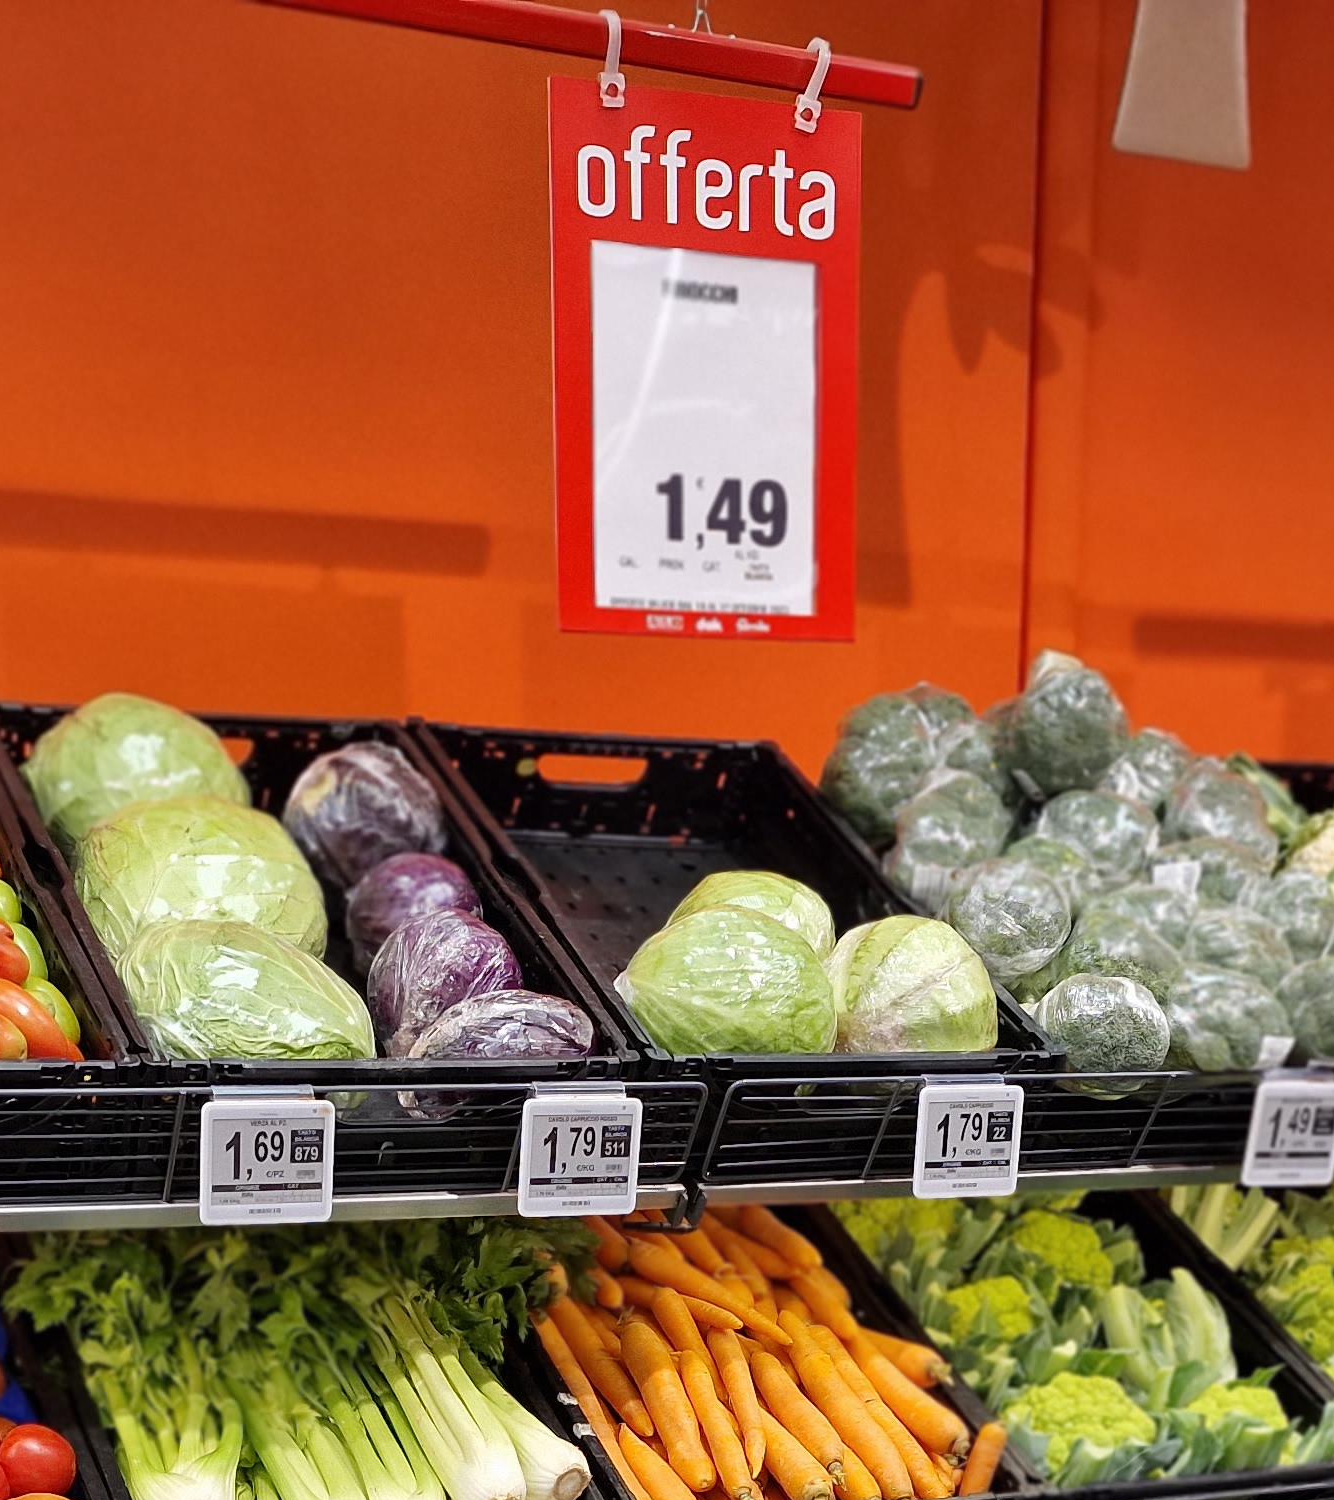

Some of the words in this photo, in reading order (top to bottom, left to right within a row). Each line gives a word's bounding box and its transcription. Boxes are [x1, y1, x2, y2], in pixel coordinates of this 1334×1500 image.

[576, 125, 836, 240] offerta
[656, 474, 788, 550] 1,49
[605, 1141, 625, 1156] 511
[937, 1113, 982, 1158] 1,79
[993, 1127, 1007, 1140] 22
[1268, 1107, 1311, 1148] 1,49
[226, 1131, 284, 1181] 1,69
[295, 1147, 318, 1161] 879
[544, 1127, 596, 1174] 1,79
[266, 1170, 284, 1178] €/PZ
